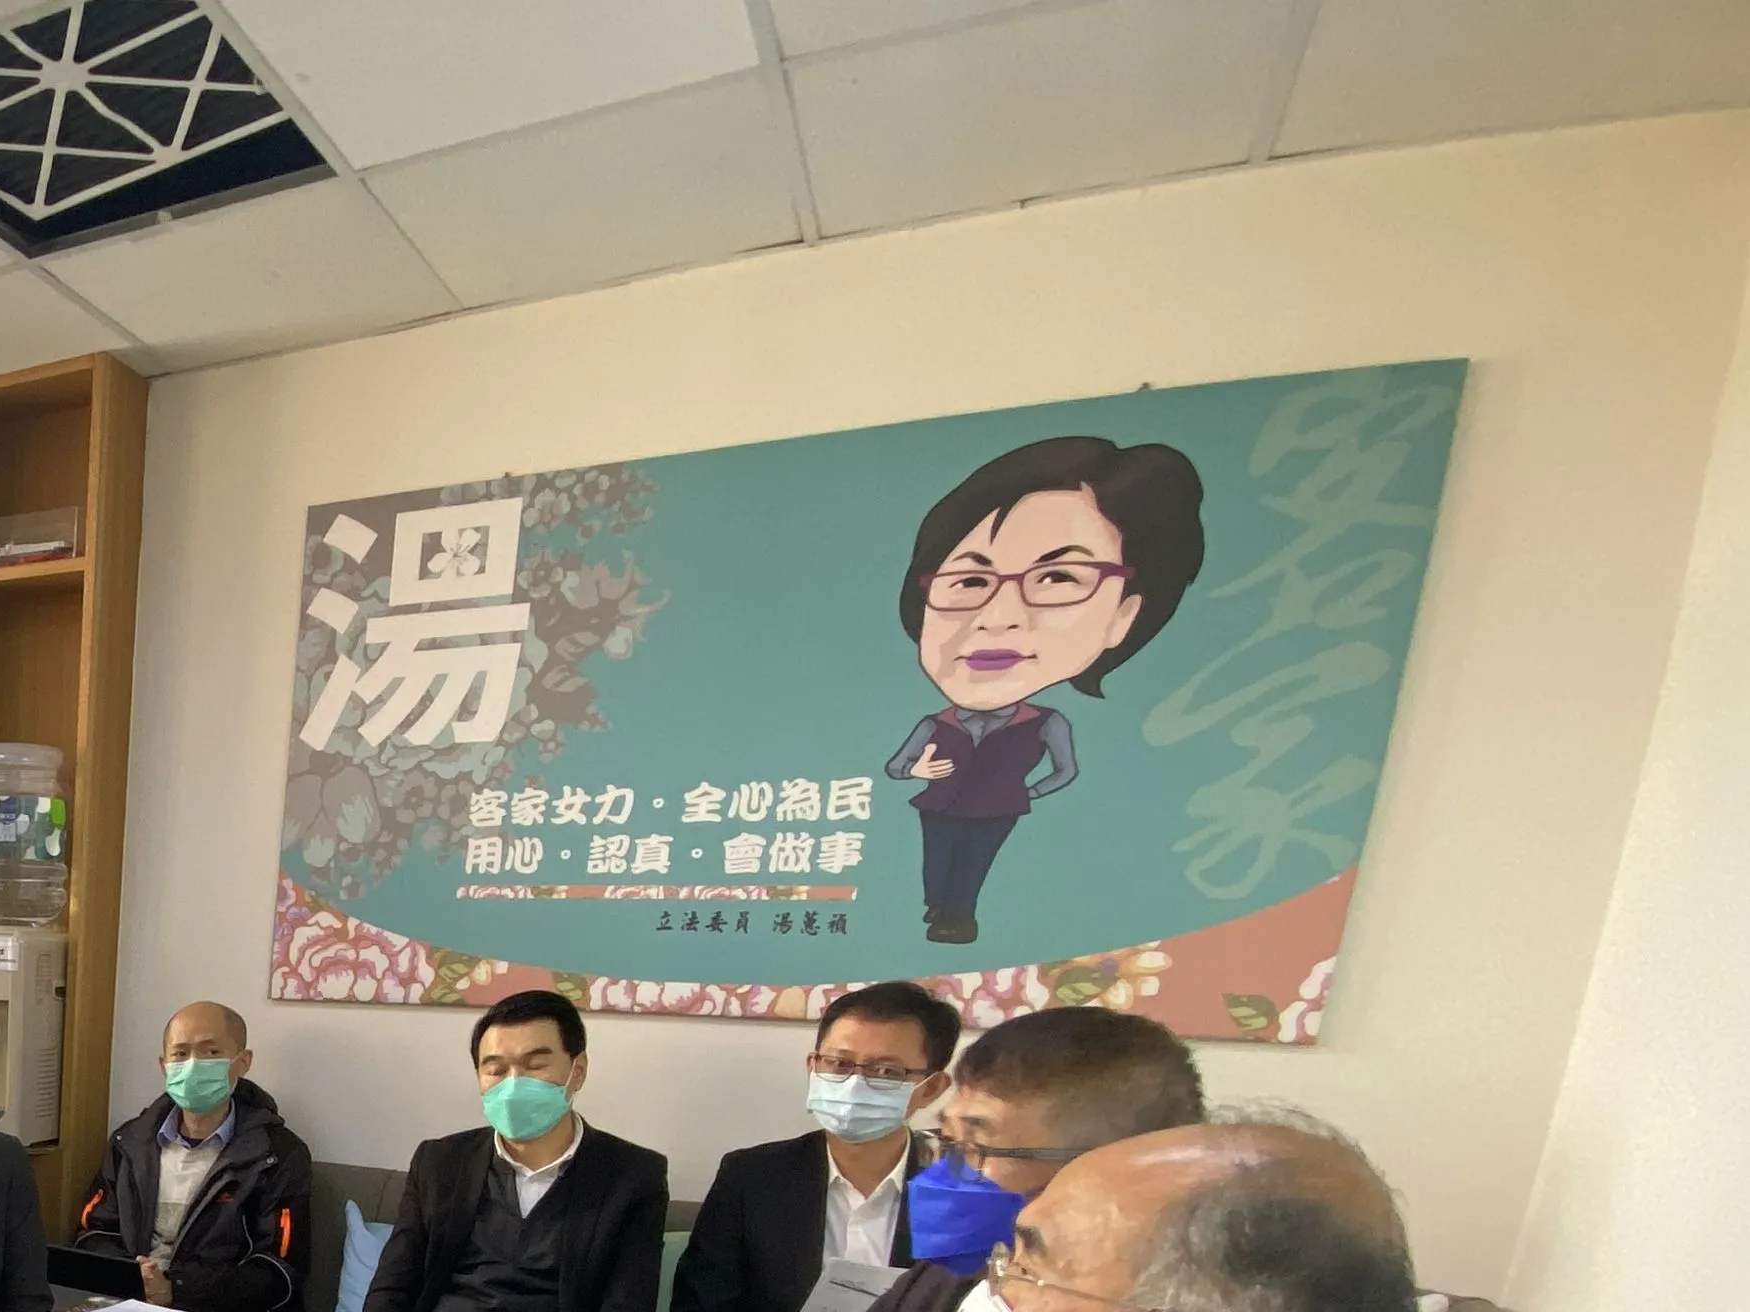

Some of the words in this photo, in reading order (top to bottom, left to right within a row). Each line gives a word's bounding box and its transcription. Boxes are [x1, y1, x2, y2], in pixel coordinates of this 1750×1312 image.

[299, 497, 531, 751] 湯
[655, 911, 750, 934] 立法委員
